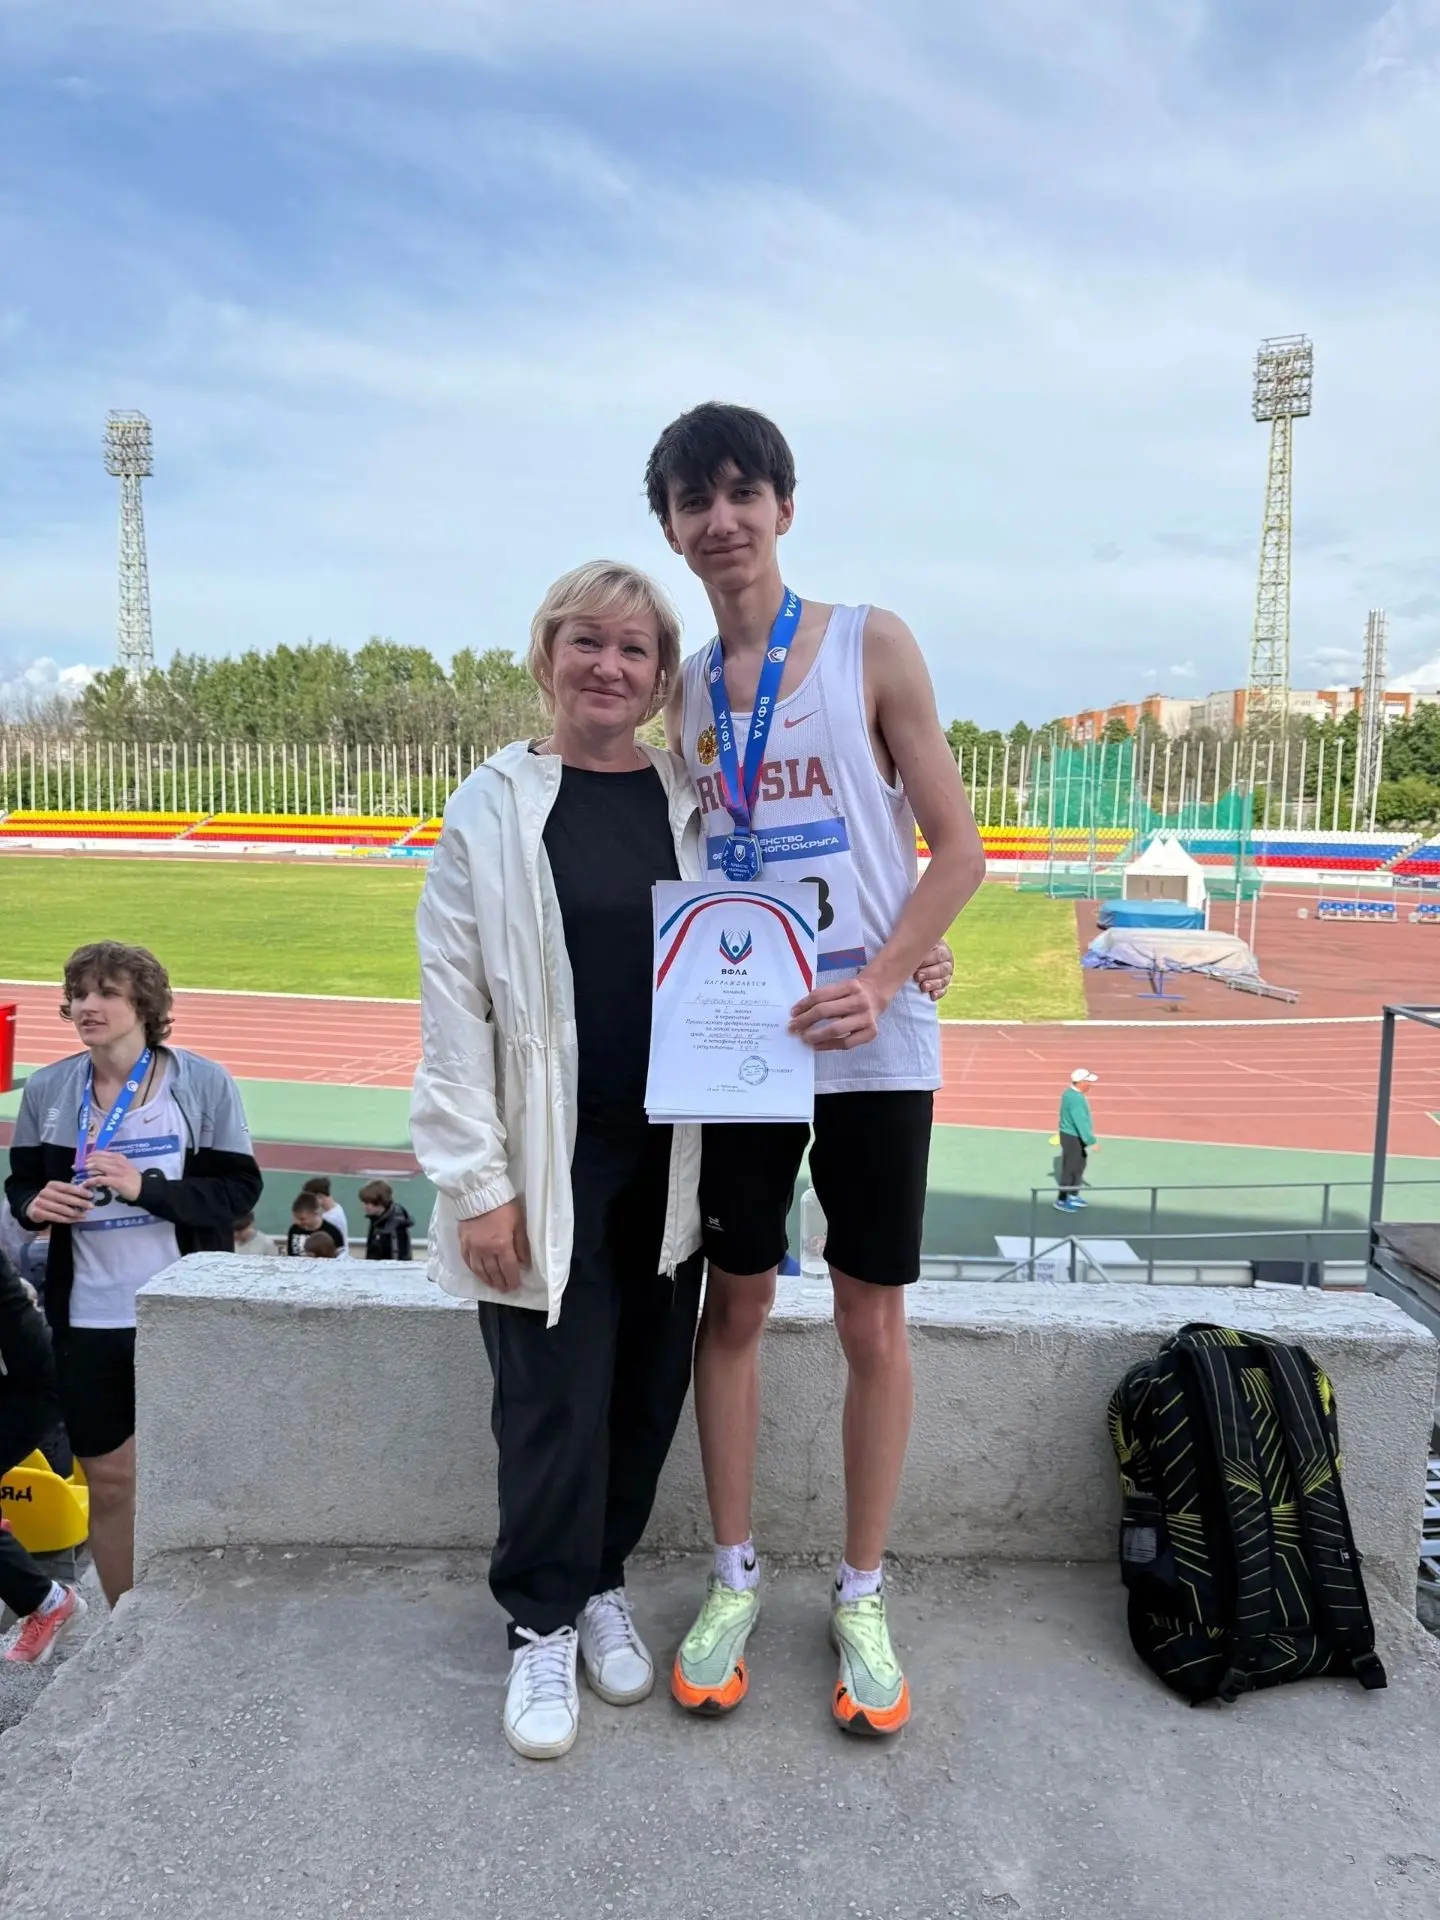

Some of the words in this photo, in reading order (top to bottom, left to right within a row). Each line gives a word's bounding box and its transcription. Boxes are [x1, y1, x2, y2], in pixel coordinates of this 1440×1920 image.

[784, 588, 798, 617] ФЛА
[753, 696, 770, 740] ВФЛА
[719, 710, 732, 752] ВФЛА
[696, 756, 833, 815] RSIA
[759, 834, 804, 846] ЕНСТВО
[790, 836, 840, 851] ОКРУГА
[721, 968, 748, 976] ВФЛА
[0, 1485, 33, 1503] ЯД
